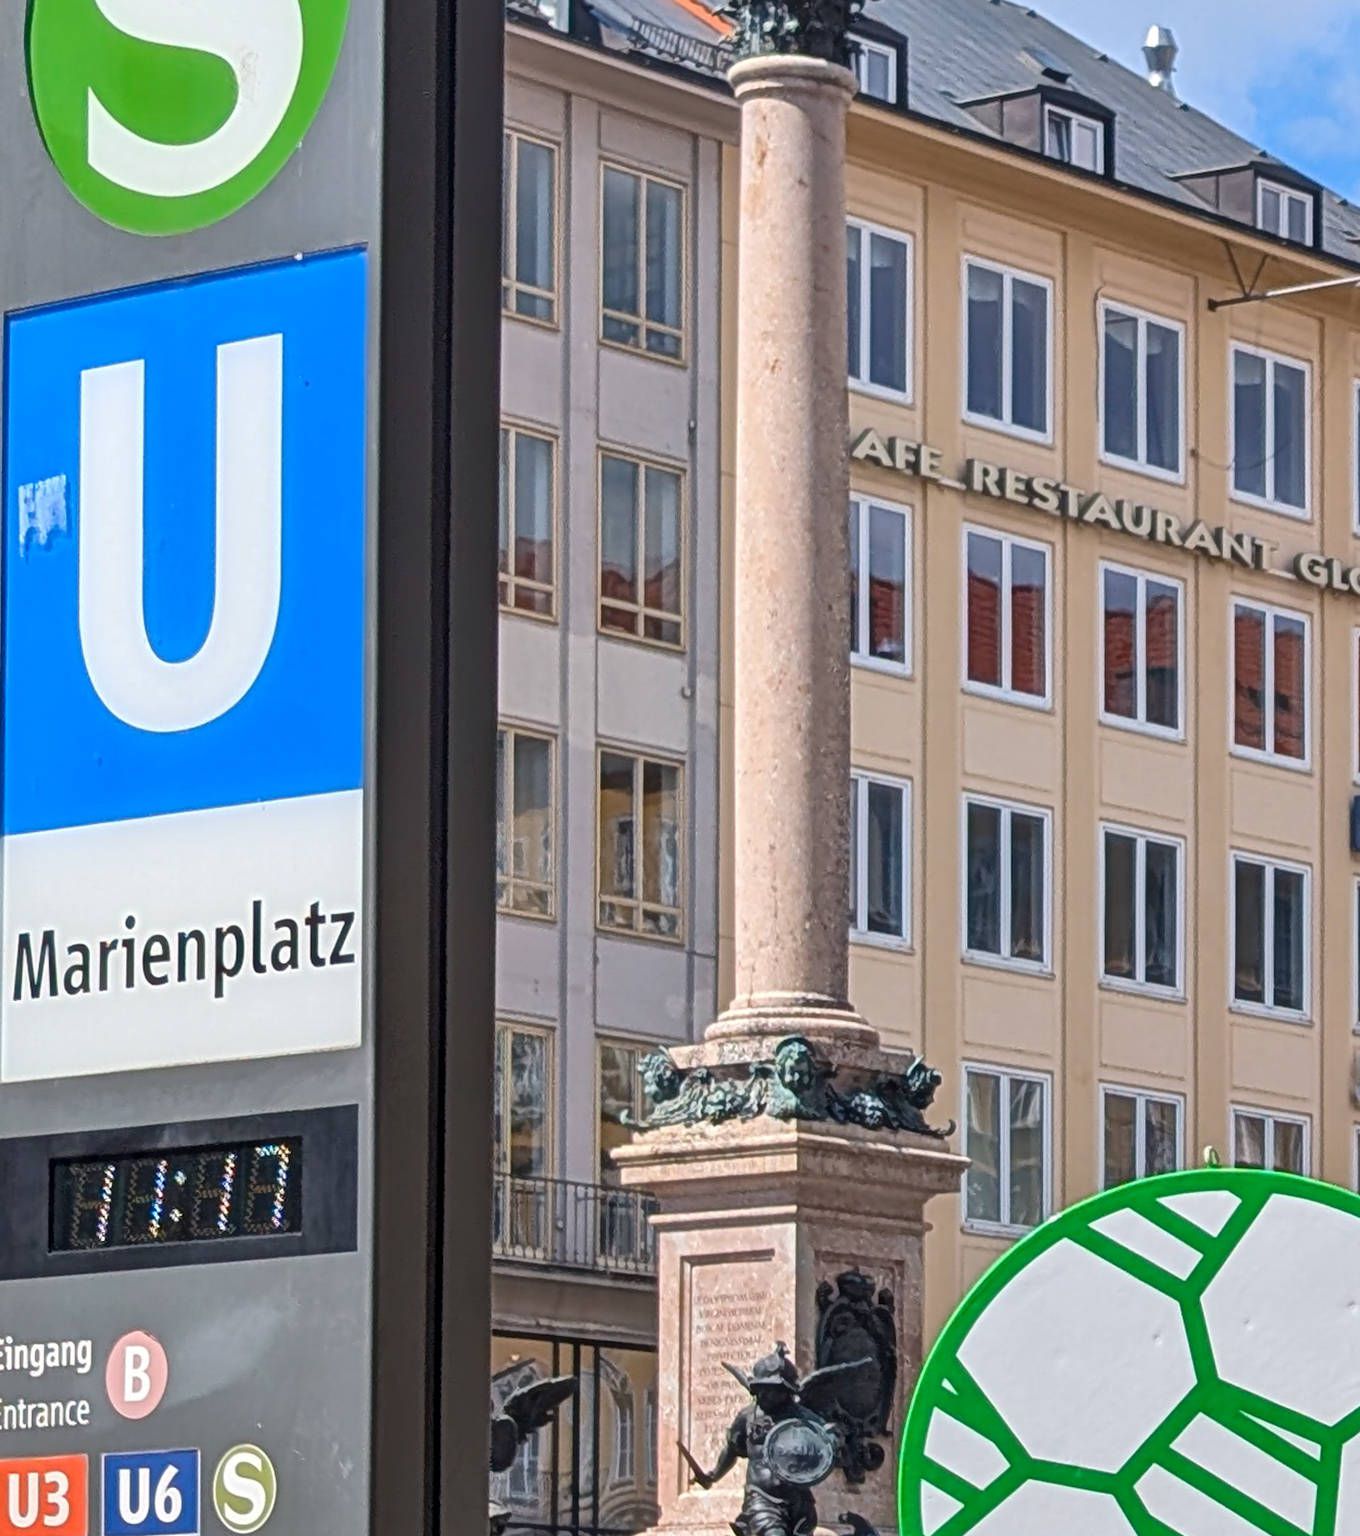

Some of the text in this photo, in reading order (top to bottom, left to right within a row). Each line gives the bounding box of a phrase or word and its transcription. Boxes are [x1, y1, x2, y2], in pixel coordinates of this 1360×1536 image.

[79, 333, 283, 733] U
[966, 458, 1278, 571] RESTAURANT
[13, 899, 356, 1001] Marienplatz
[0, 1397, 90, 1430] ntrance
[124, 1345, 151, 1402] B
[8, 1452, 266, 1529] U3 U6 S
